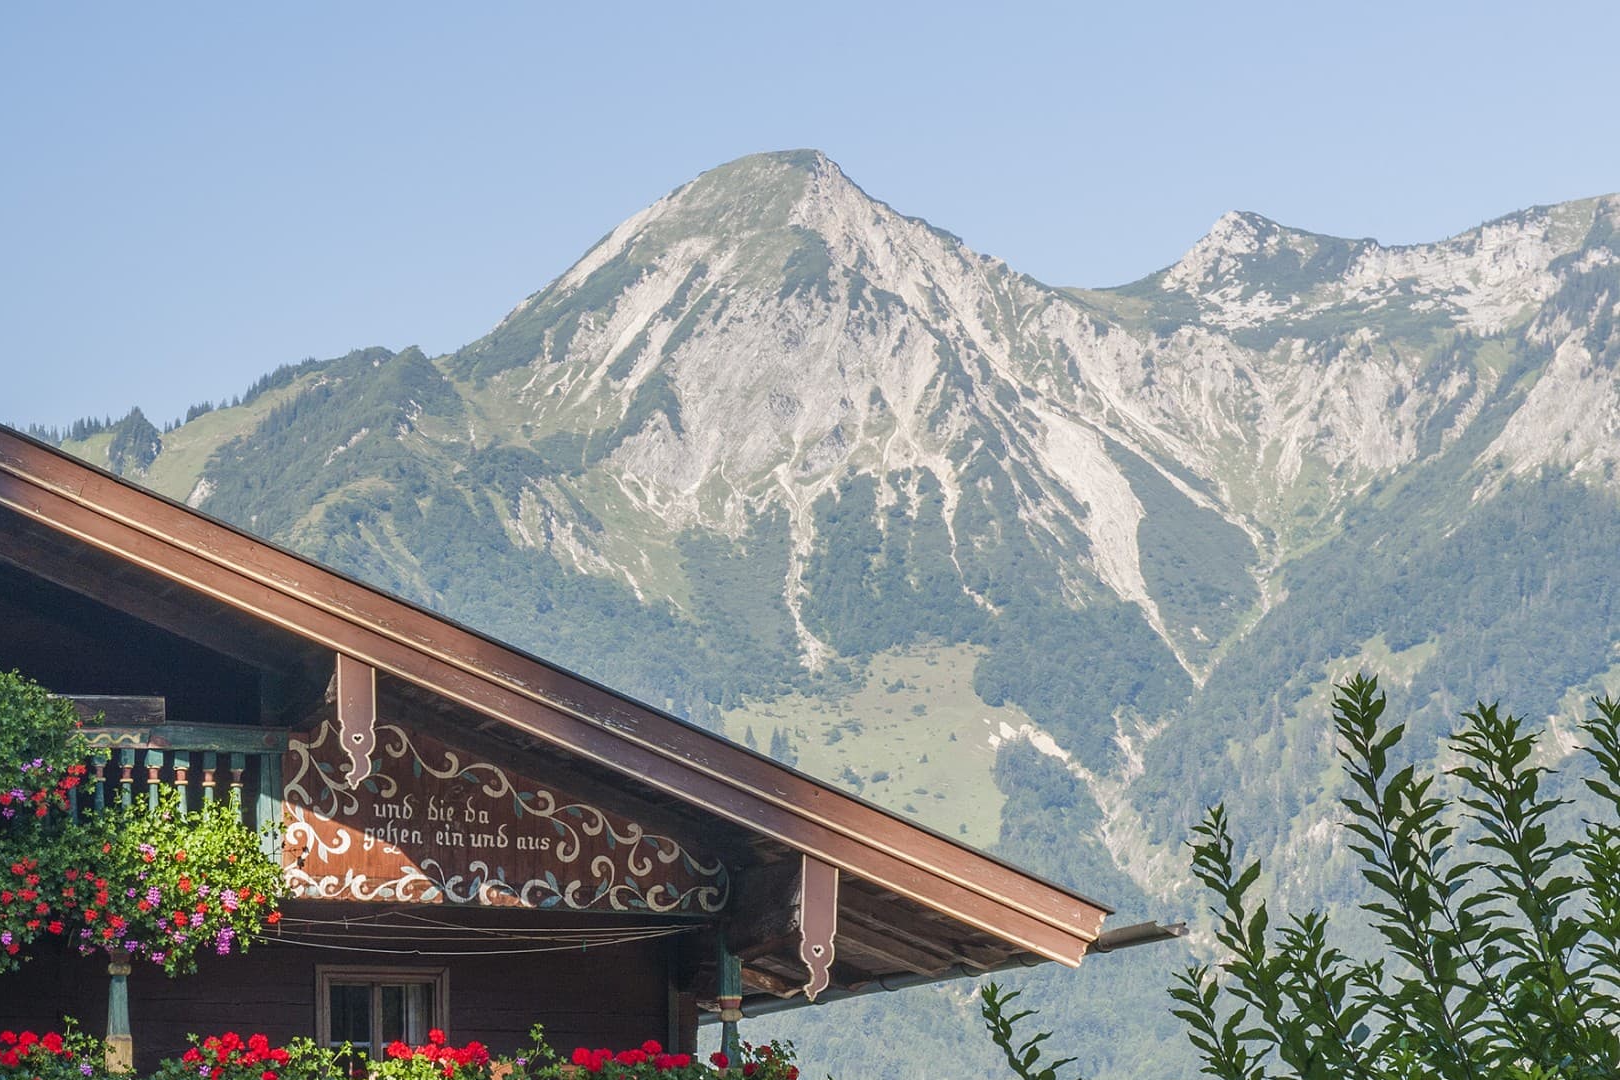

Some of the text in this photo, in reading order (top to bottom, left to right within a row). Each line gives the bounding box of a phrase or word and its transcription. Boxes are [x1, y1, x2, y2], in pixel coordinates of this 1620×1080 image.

[373, 794, 490, 824] und die da
[364, 820, 551, 854] gehen ein und aus
